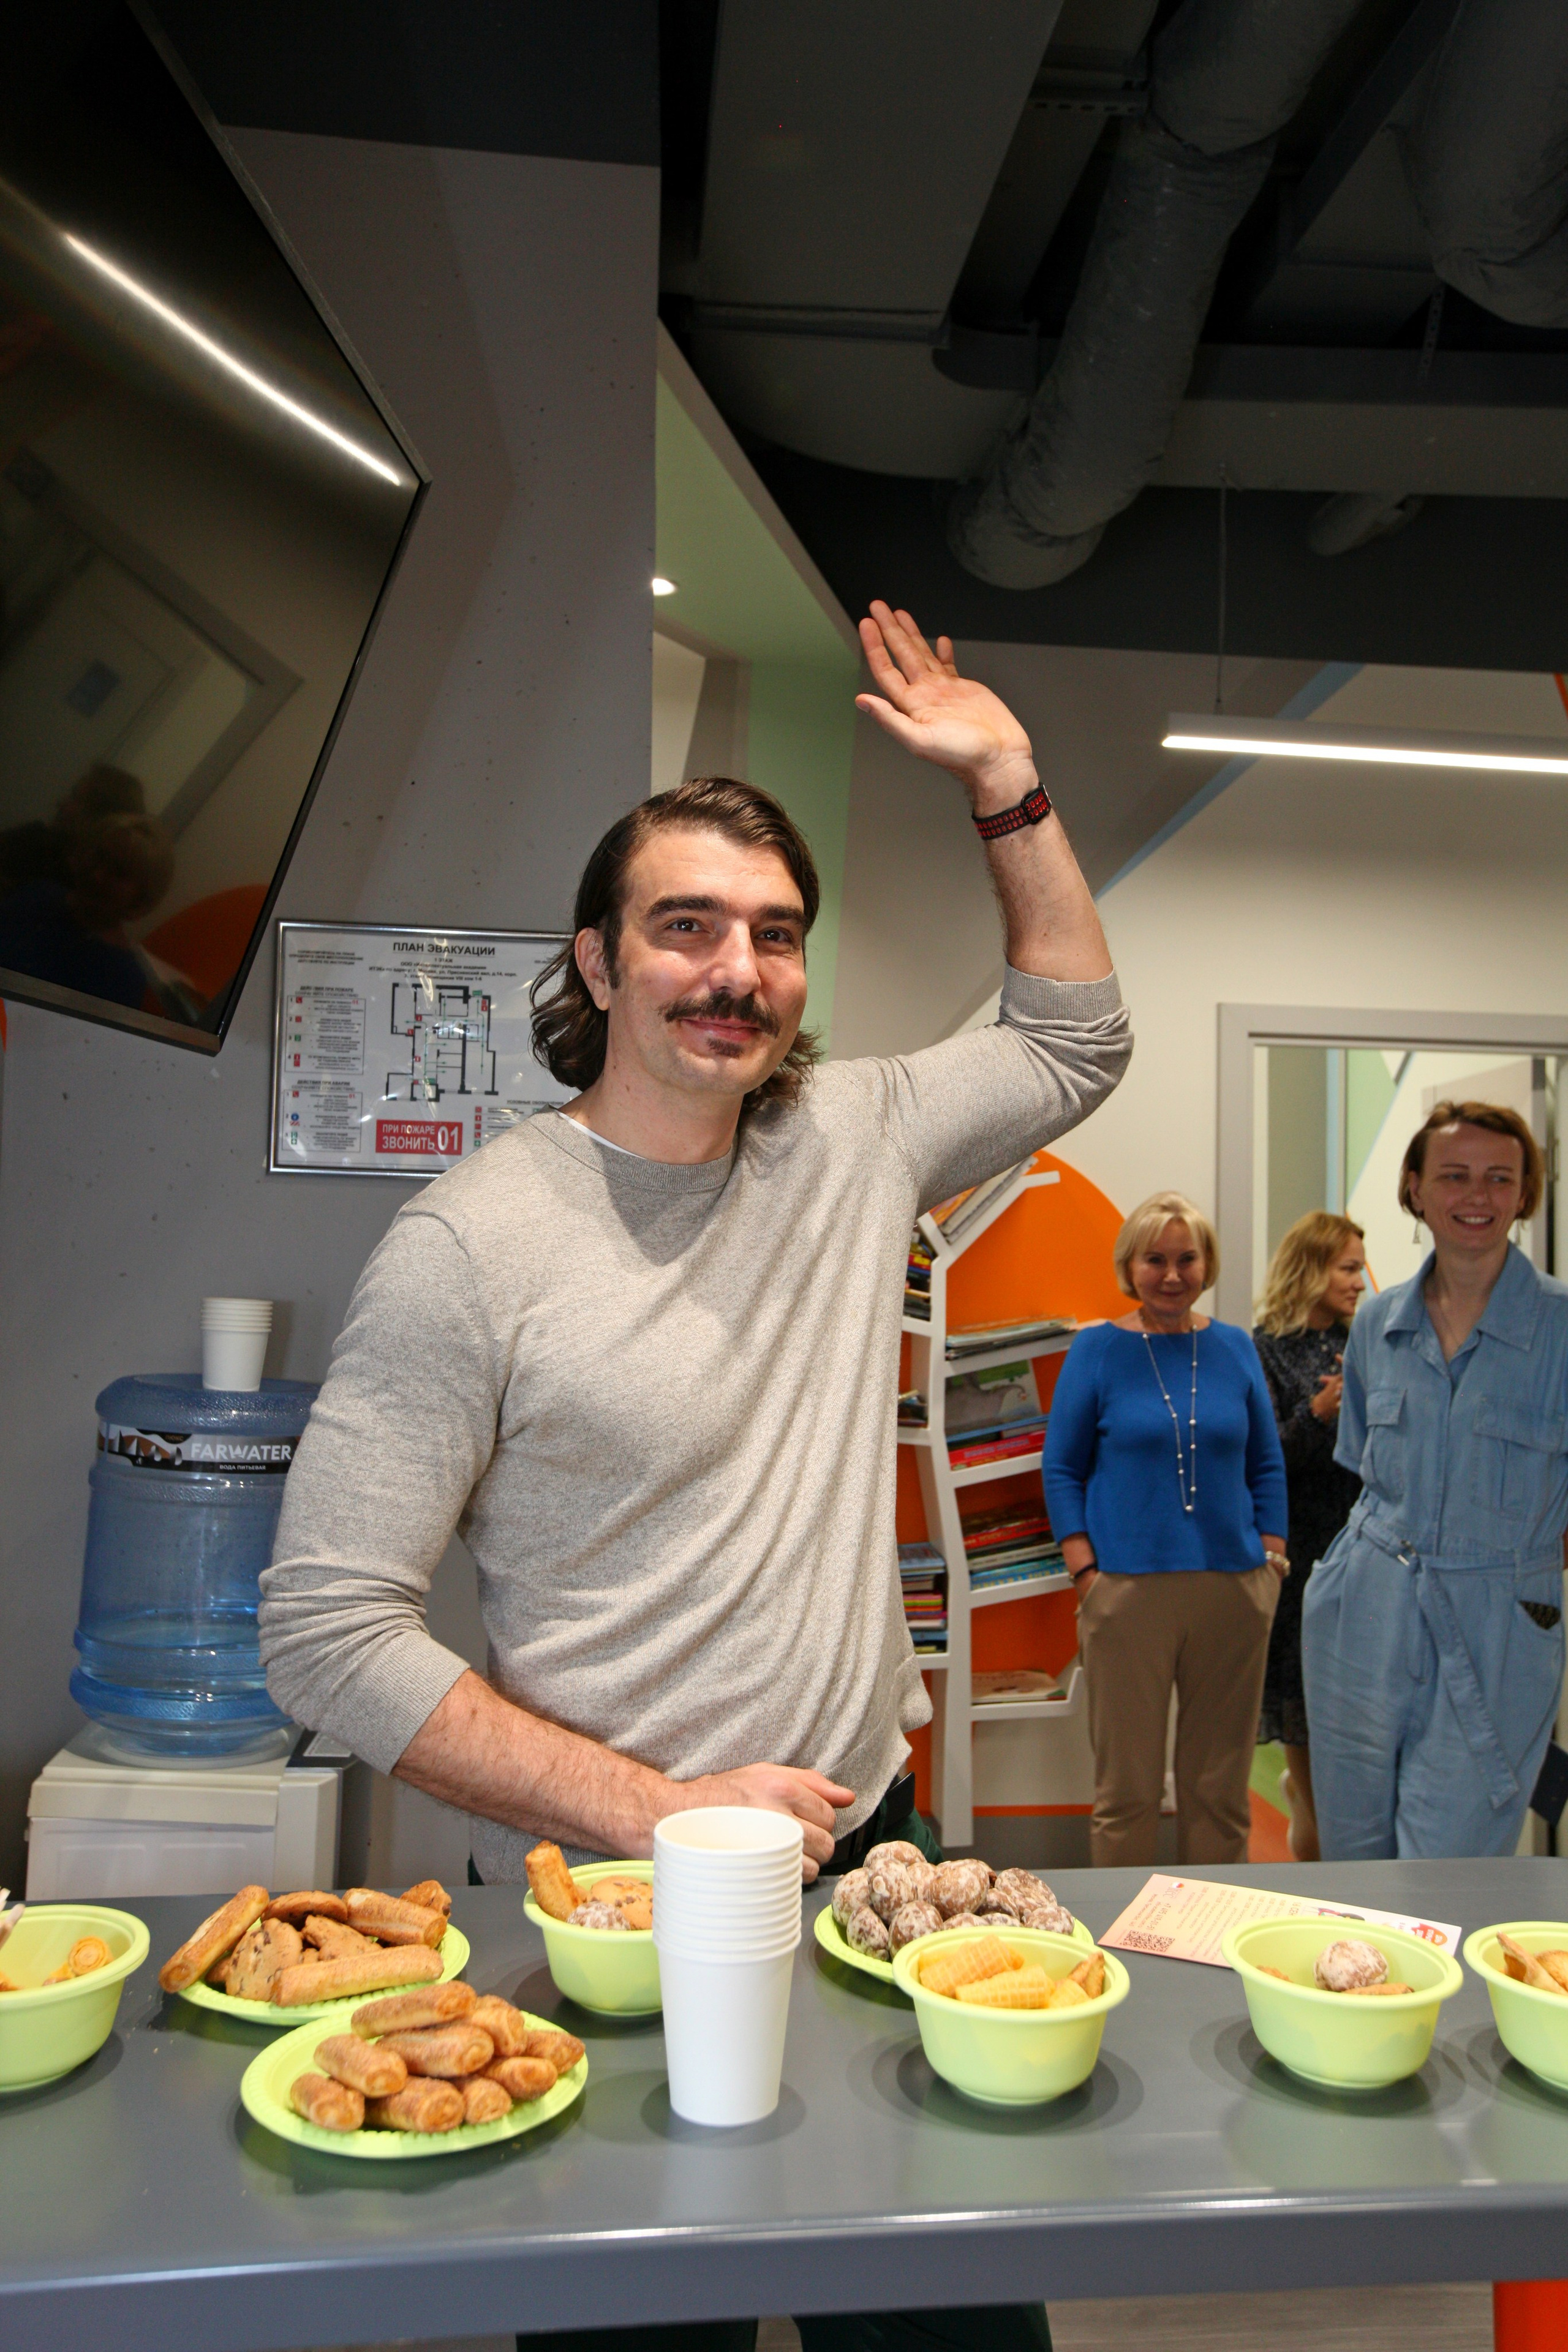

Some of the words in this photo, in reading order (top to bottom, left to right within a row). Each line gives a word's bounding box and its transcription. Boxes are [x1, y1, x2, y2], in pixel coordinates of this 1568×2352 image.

[393, 942, 424, 952] ПЛАН
[428, 944, 496, 956] ЭВАКУАЦИИ
[382, 1124, 398, 1133] ПРИ
[401, 1125, 435, 1135] ПОЖАРЕ
[382, 1136, 435, 1150] ЗВОНИТЬ
[437, 1125, 459, 1151] 01
[190, 1442, 292, 1461] FARWATER
